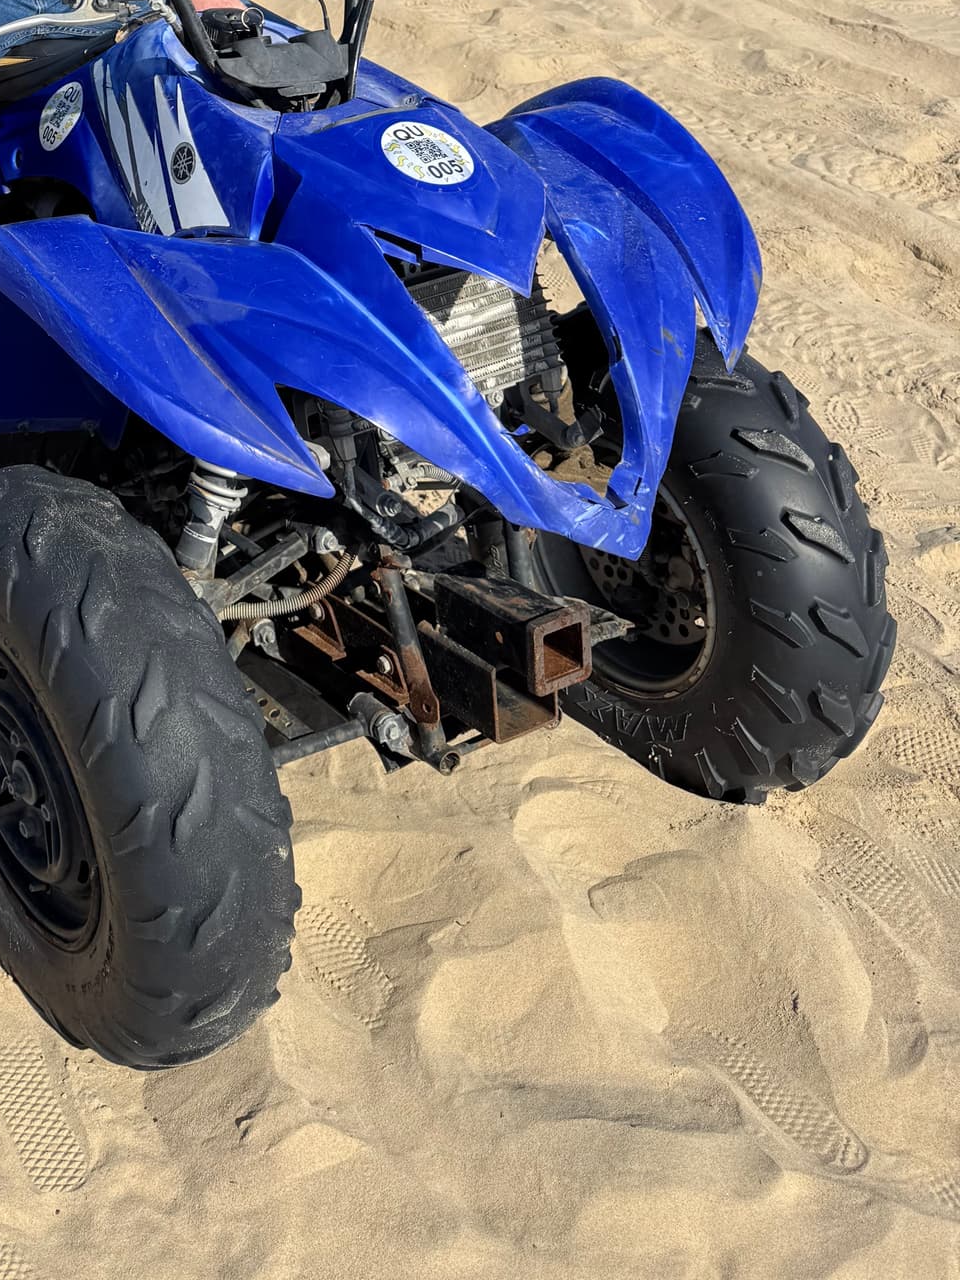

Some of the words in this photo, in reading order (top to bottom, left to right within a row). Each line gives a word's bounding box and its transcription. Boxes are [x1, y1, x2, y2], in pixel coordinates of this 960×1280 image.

[64, 86, 80, 103] QU
[42, 125, 58, 145] 005
[393, 125, 424, 141] QU
[427, 160, 463, 179] 005
[562, 684, 689, 743] MAX
